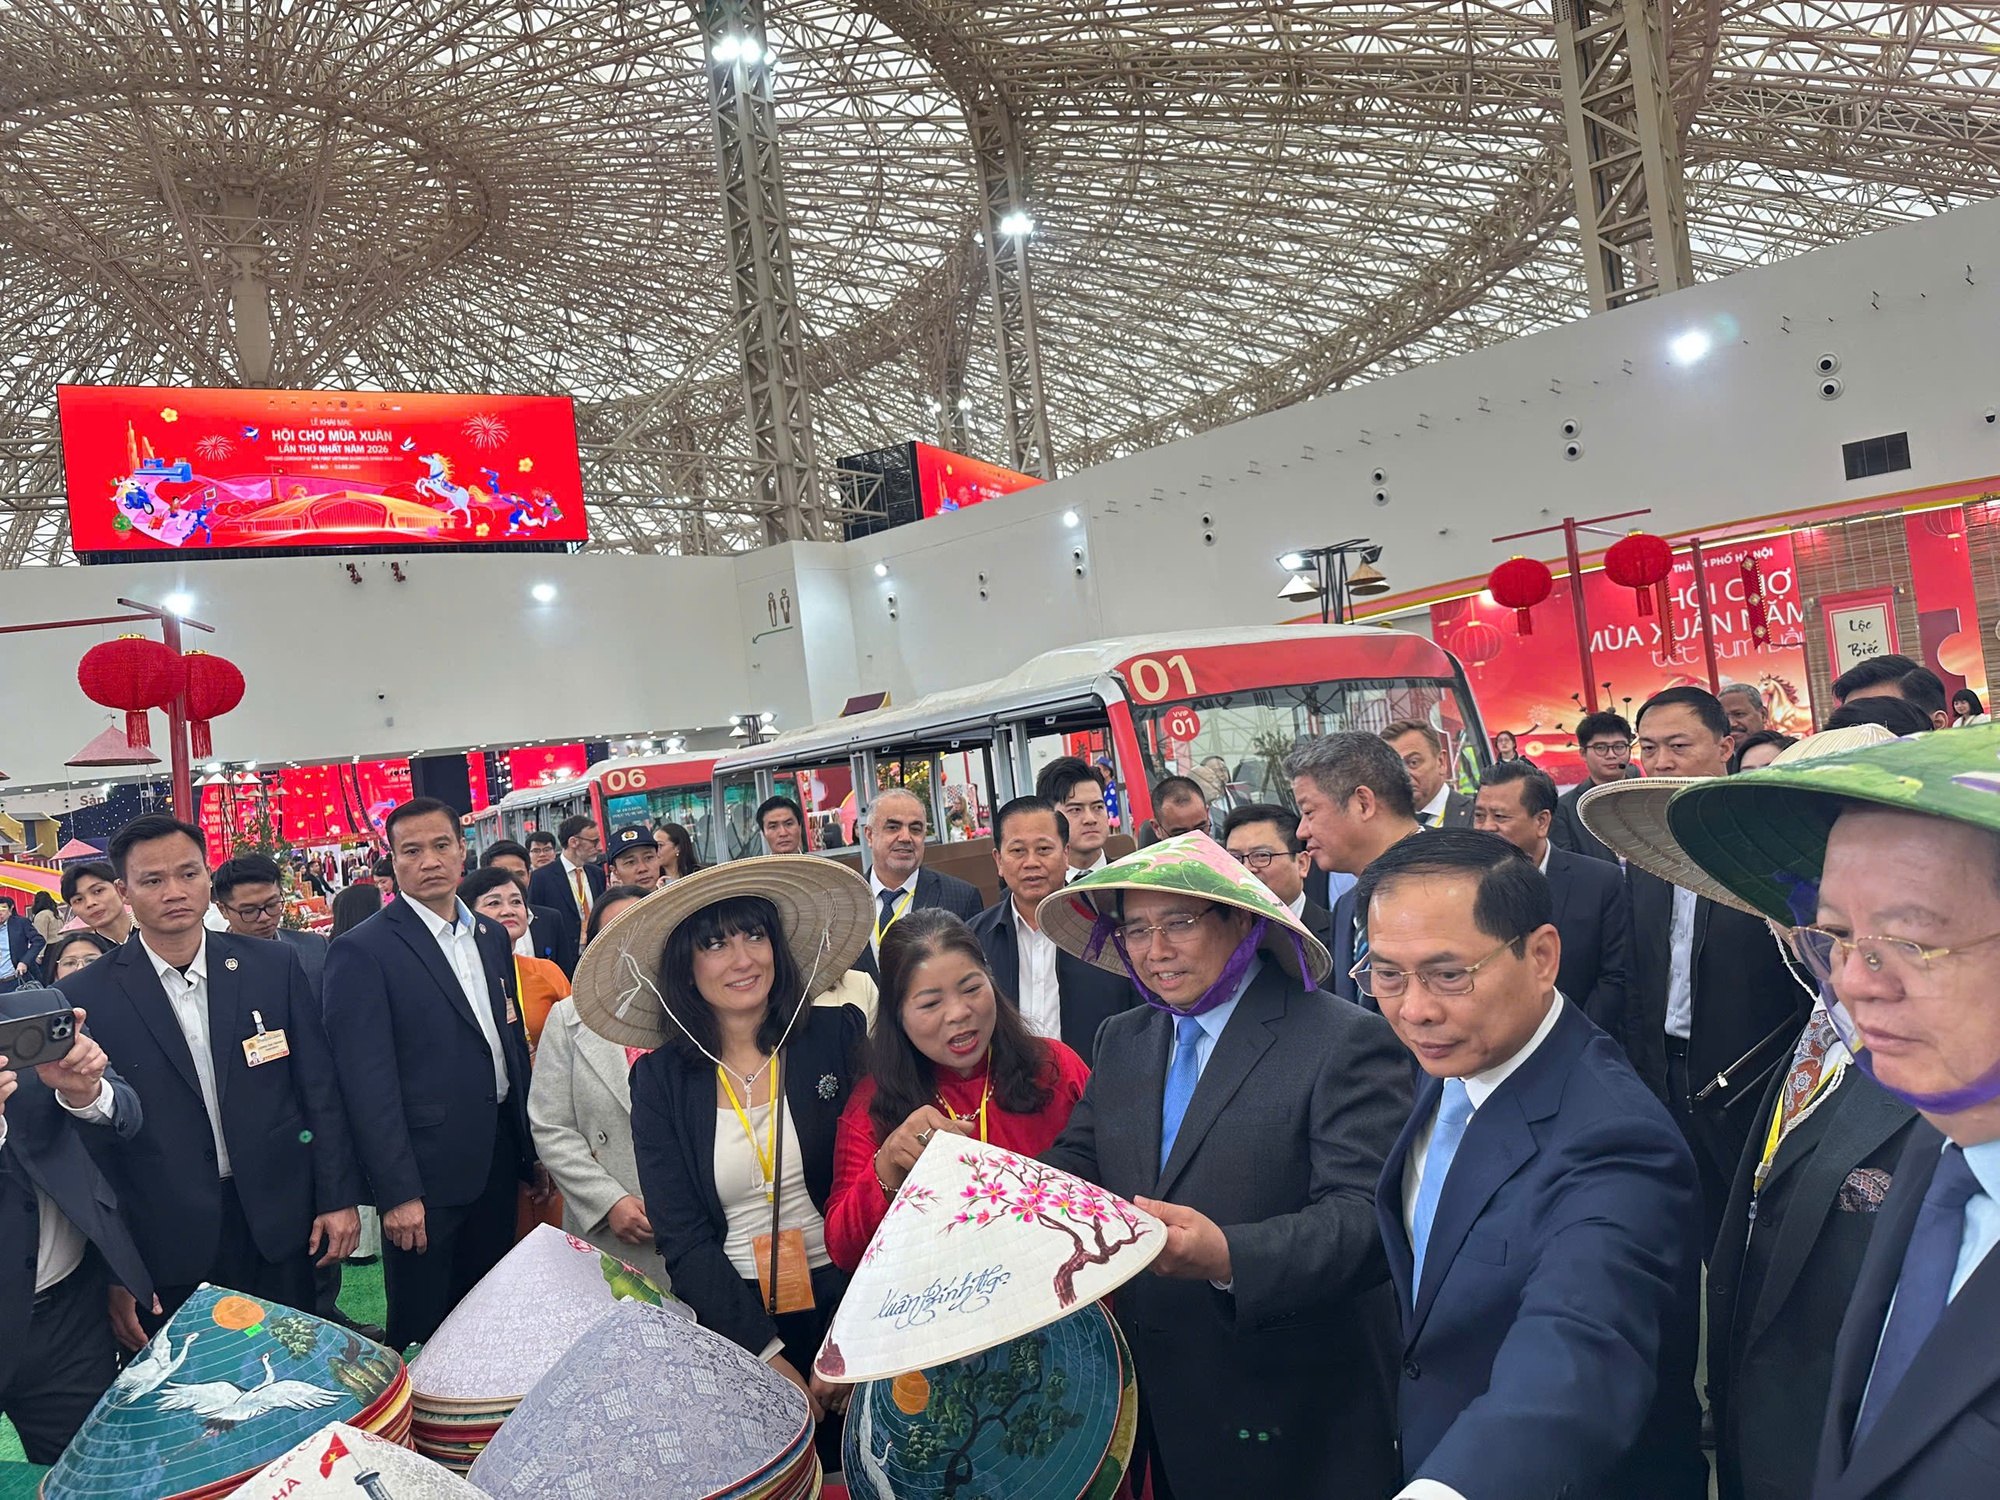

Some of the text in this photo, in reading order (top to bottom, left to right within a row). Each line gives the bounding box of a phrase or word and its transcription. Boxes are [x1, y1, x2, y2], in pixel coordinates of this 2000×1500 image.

[319, 418, 336, 426] KHAI
[271, 428, 393, 442] HỘI CHỢ MÙA XUÂN
[278, 442, 389, 454] LẦN THỨ NHẤT NĂM 2026
[1673, 559, 1708, 573] THÀH
[1710, 553, 1733, 567] PHỐ
[1849, 619, 1873, 632] Lộc
[1847, 640, 1880, 657] Biếc
[1130, 655, 1197, 702] 01
[1172, 710, 1189, 718] VVIP
[1172, 717, 1196, 736] 01
[607, 768, 647, 792] 06
[271, 1477, 302, 1500] HÀ
